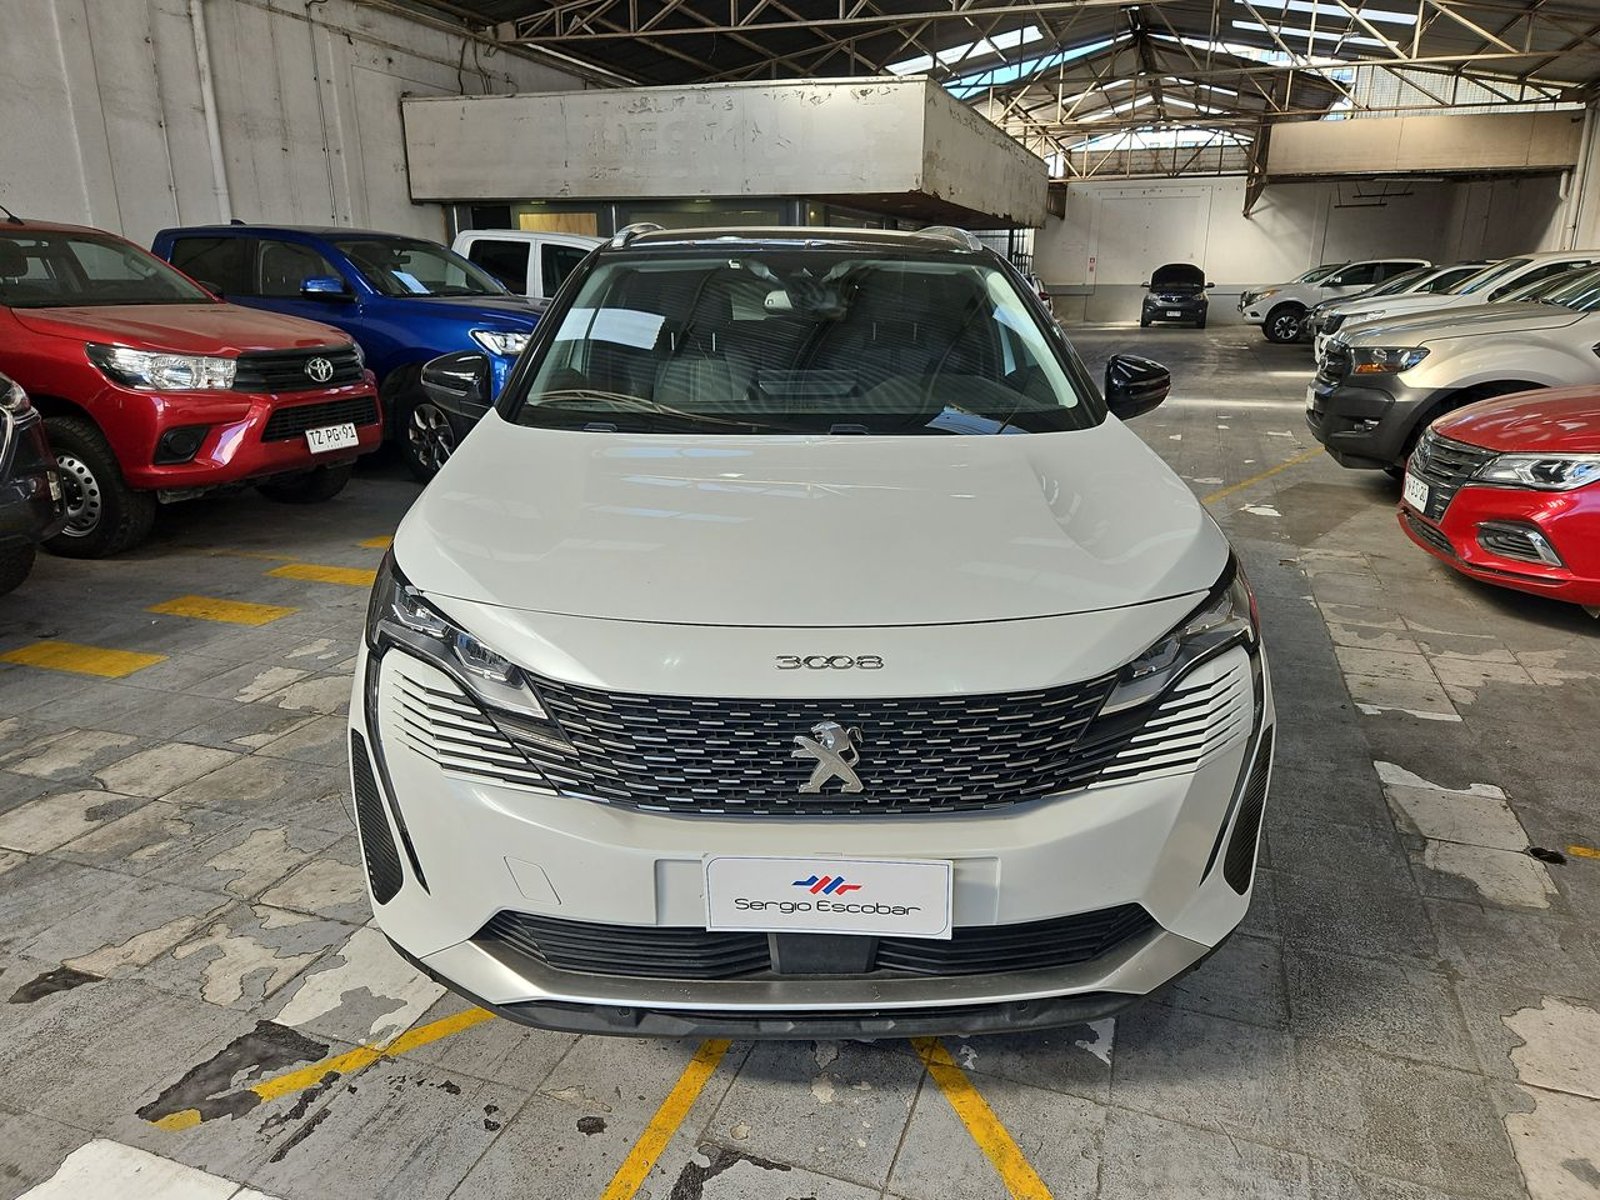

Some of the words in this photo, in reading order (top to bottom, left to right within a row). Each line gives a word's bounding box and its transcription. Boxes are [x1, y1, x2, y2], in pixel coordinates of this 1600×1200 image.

[775, 655, 884, 670] 3008
[734, 898, 812, 914] Sergio
[816, 900, 921, 916] Escobar
